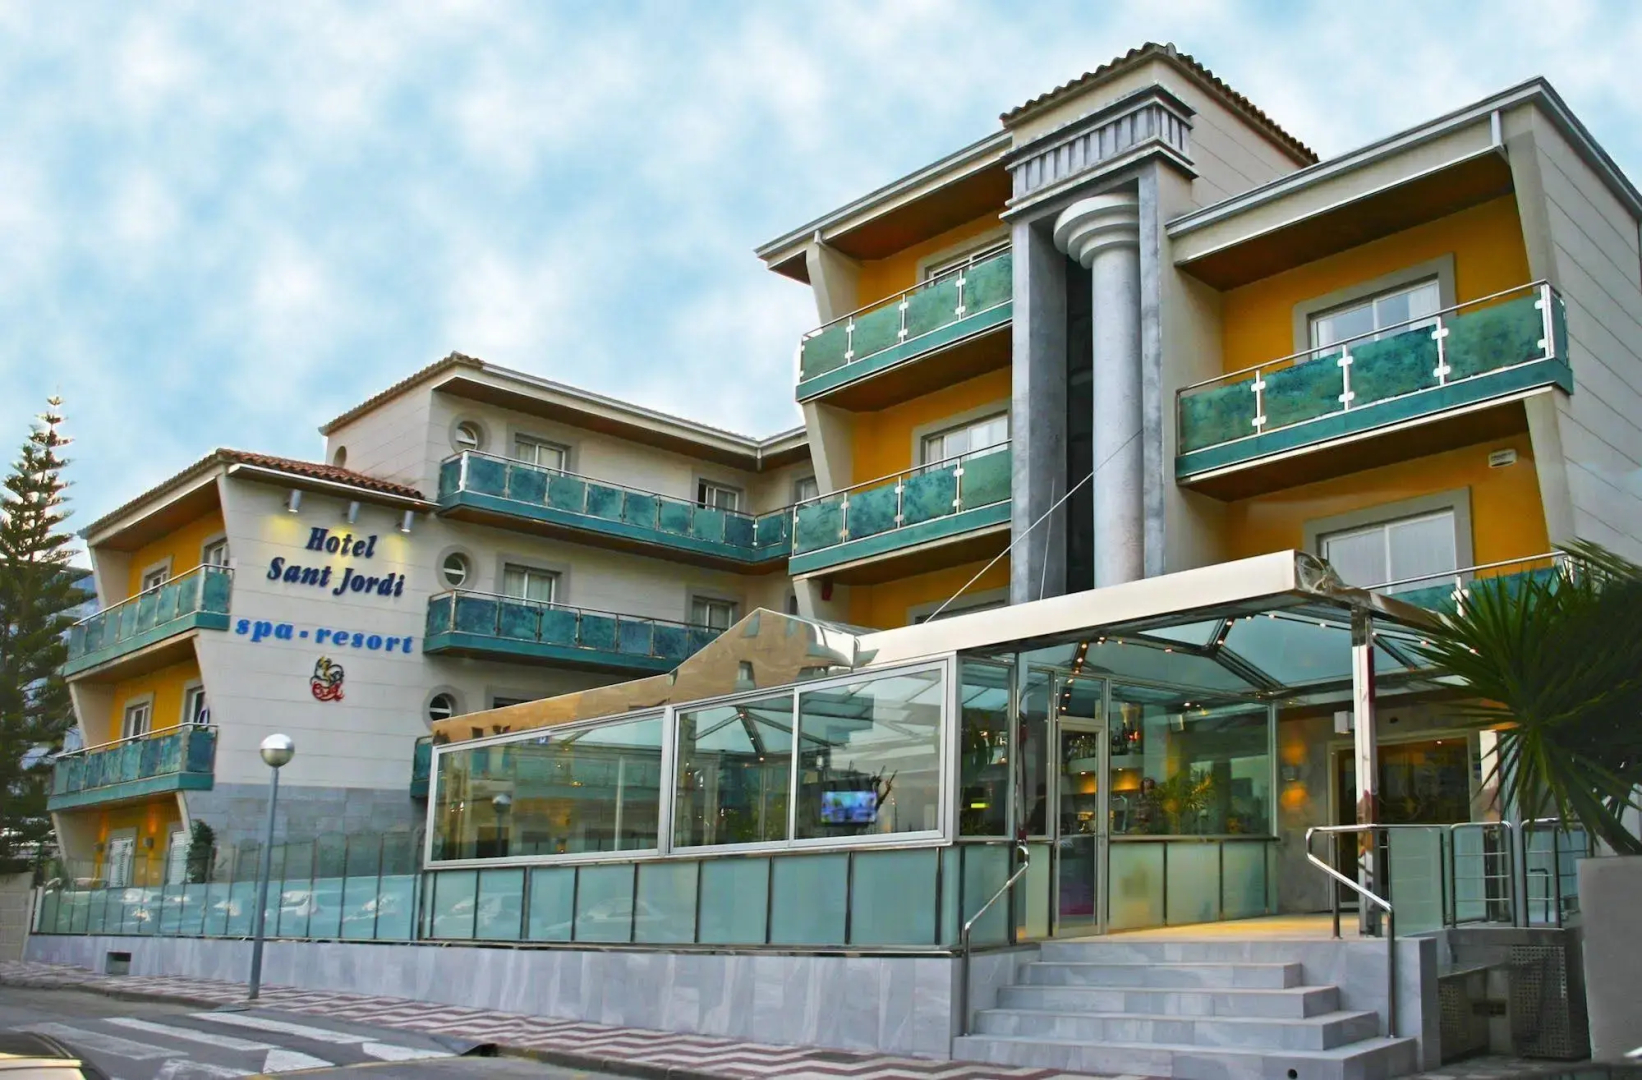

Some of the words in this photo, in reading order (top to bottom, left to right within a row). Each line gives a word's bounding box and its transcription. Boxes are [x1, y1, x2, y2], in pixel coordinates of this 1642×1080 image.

[305, 527, 377, 558] Hotel
[266, 557, 332, 587] Sant
[332, 567, 405, 597] Jordi
